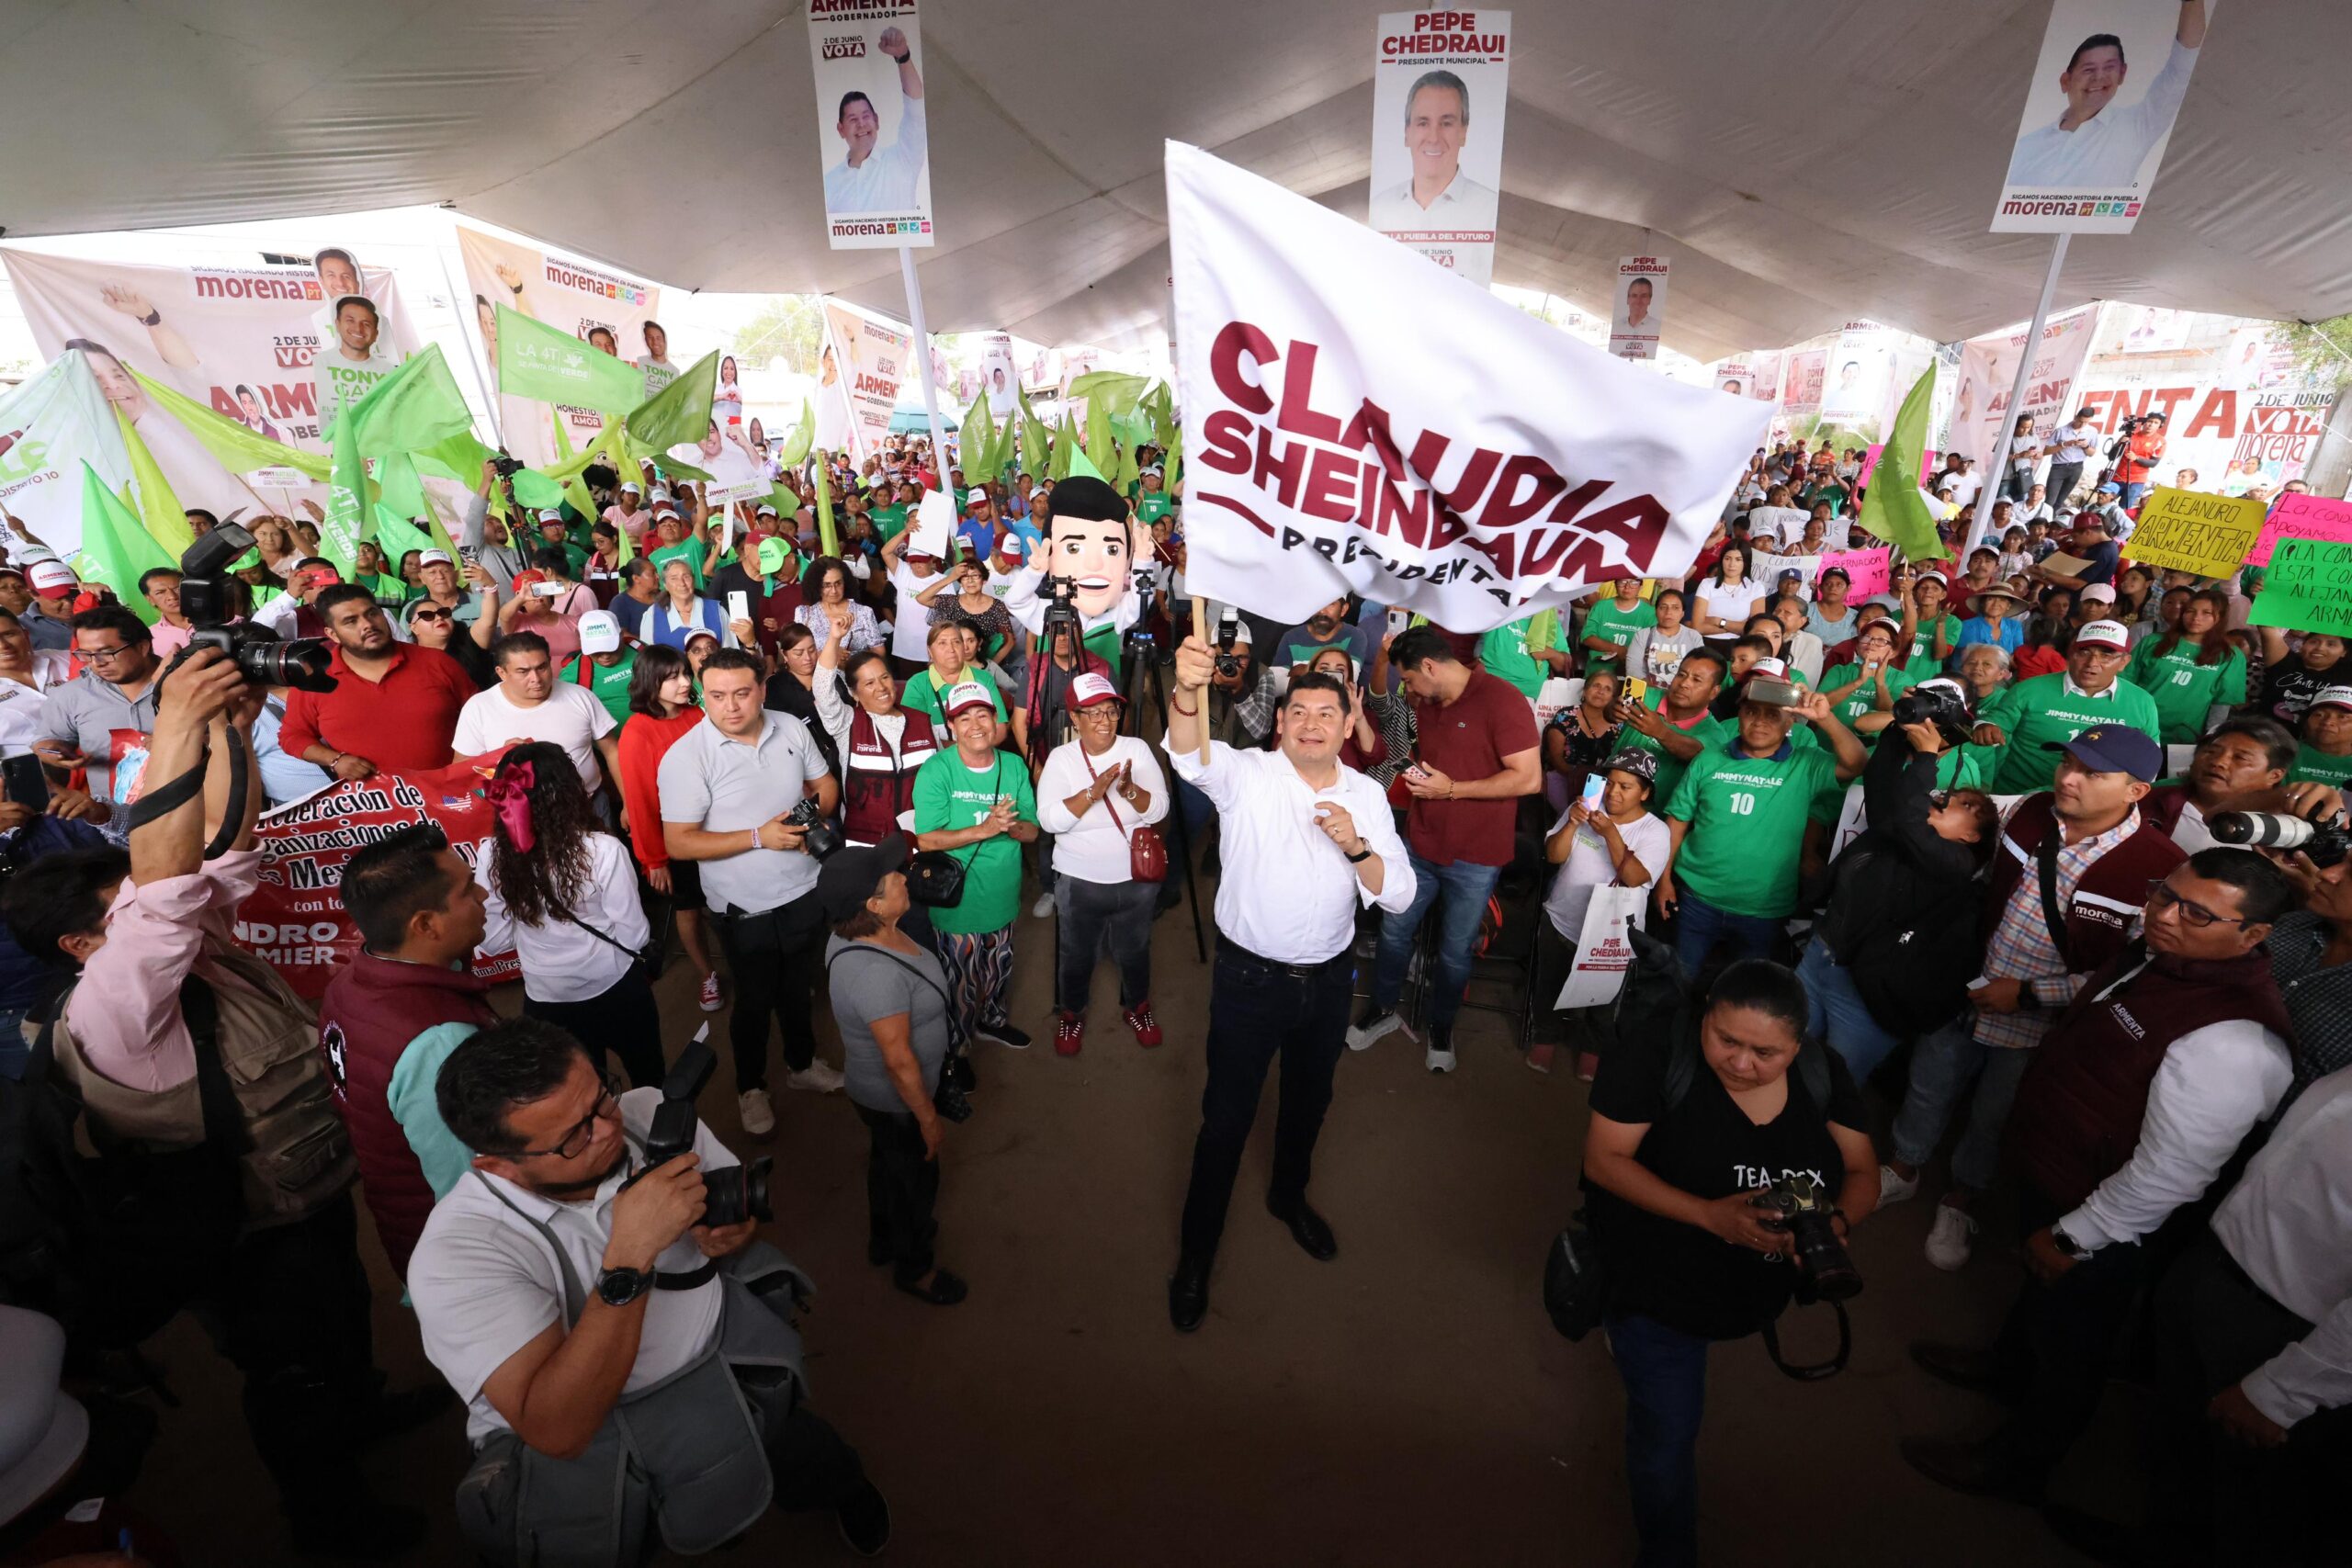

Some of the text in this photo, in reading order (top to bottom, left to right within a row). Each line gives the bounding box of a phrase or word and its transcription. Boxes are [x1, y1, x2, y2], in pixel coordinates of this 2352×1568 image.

[830, 11, 897, 22] GOBERNADOR
[1414, 12, 1476, 32] PEPE
[823, 44, 864, 57] VOTA
[1382, 34, 1506, 55] CHEDRAUI
[1397, 58, 1444, 66] PRESIDENTE
[2002, 200, 2078, 216] morena
[832, 223, 885, 236] morena
[547, 257, 571, 268] SIGAMOS
[571, 265, 597, 276] HACIENDO
[598, 273, 619, 284] HISTORIA
[196, 276, 304, 299] morena
[547, 266, 605, 296] morena
[586, 319, 594, 327] DE
[274, 336, 282, 346] 2
[286, 336, 302, 345] DE
[865, 325, 889, 343] morena
[515, 341, 558, 361] LA 4T
[560, 368, 589, 379] VERDE
[645, 365, 674, 379] TONY
[2255, 393, 2335, 406] 2 DE JUNIO
[556, 403, 598, 416] HONESTID
[2075, 386, 2237, 438] ENTA
[573, 416, 599, 426] AMOR
[2251, 408, 2326, 434] VOTA
[1210, 321, 1671, 574] CLAUDIA
[2233, 434, 2307, 463] morena
[44, 470, 59, 480] 10
[332, 485, 361, 508] 4T
[708, 488, 729, 497] JIMMY
[2162, 495, 2242, 524] ALEJANDRO
[327, 520, 358, 558] VERDE
[2132, 514, 2252, 564] ARMENTA
[2132, 549, 2153, 561] San
[39, 570, 70, 581] ARMENTA
[2275, 565, 2314, 581] ESTA
[2290, 583, 2352, 604] ALEJAN
[2084, 630, 2118, 638] NATALE
[2087, 624, 2117, 632] JIMMY
[1613, 634, 1627, 646] 10
[603, 671, 626, 684] JIMMY
[2171, 670, 2193, 686] 10
[953, 684, 978, 694] JIMMY
[1849, 702, 1869, 716] 10
[2045, 709, 2080, 720] JIMMY
[2080, 715, 2125, 726] NATALE
[1712, 772, 1783, 786] JIMMY NATALE
[2299, 766, 2334, 777] JIMMY
[255, 776, 424, 830] ederación de
[952, 791, 978, 799] JIMMY
[1730, 792, 1755, 816] 10
[294, 899, 323, 912] con
[2075, 906, 2123, 926] morena
[232, 921, 339, 943] NDRO
[255, 946, 335, 964] MIER
[2112, 1002, 2146, 1039] ARMENTA
[1734, 1165, 1825, 1189] TEA-DX
